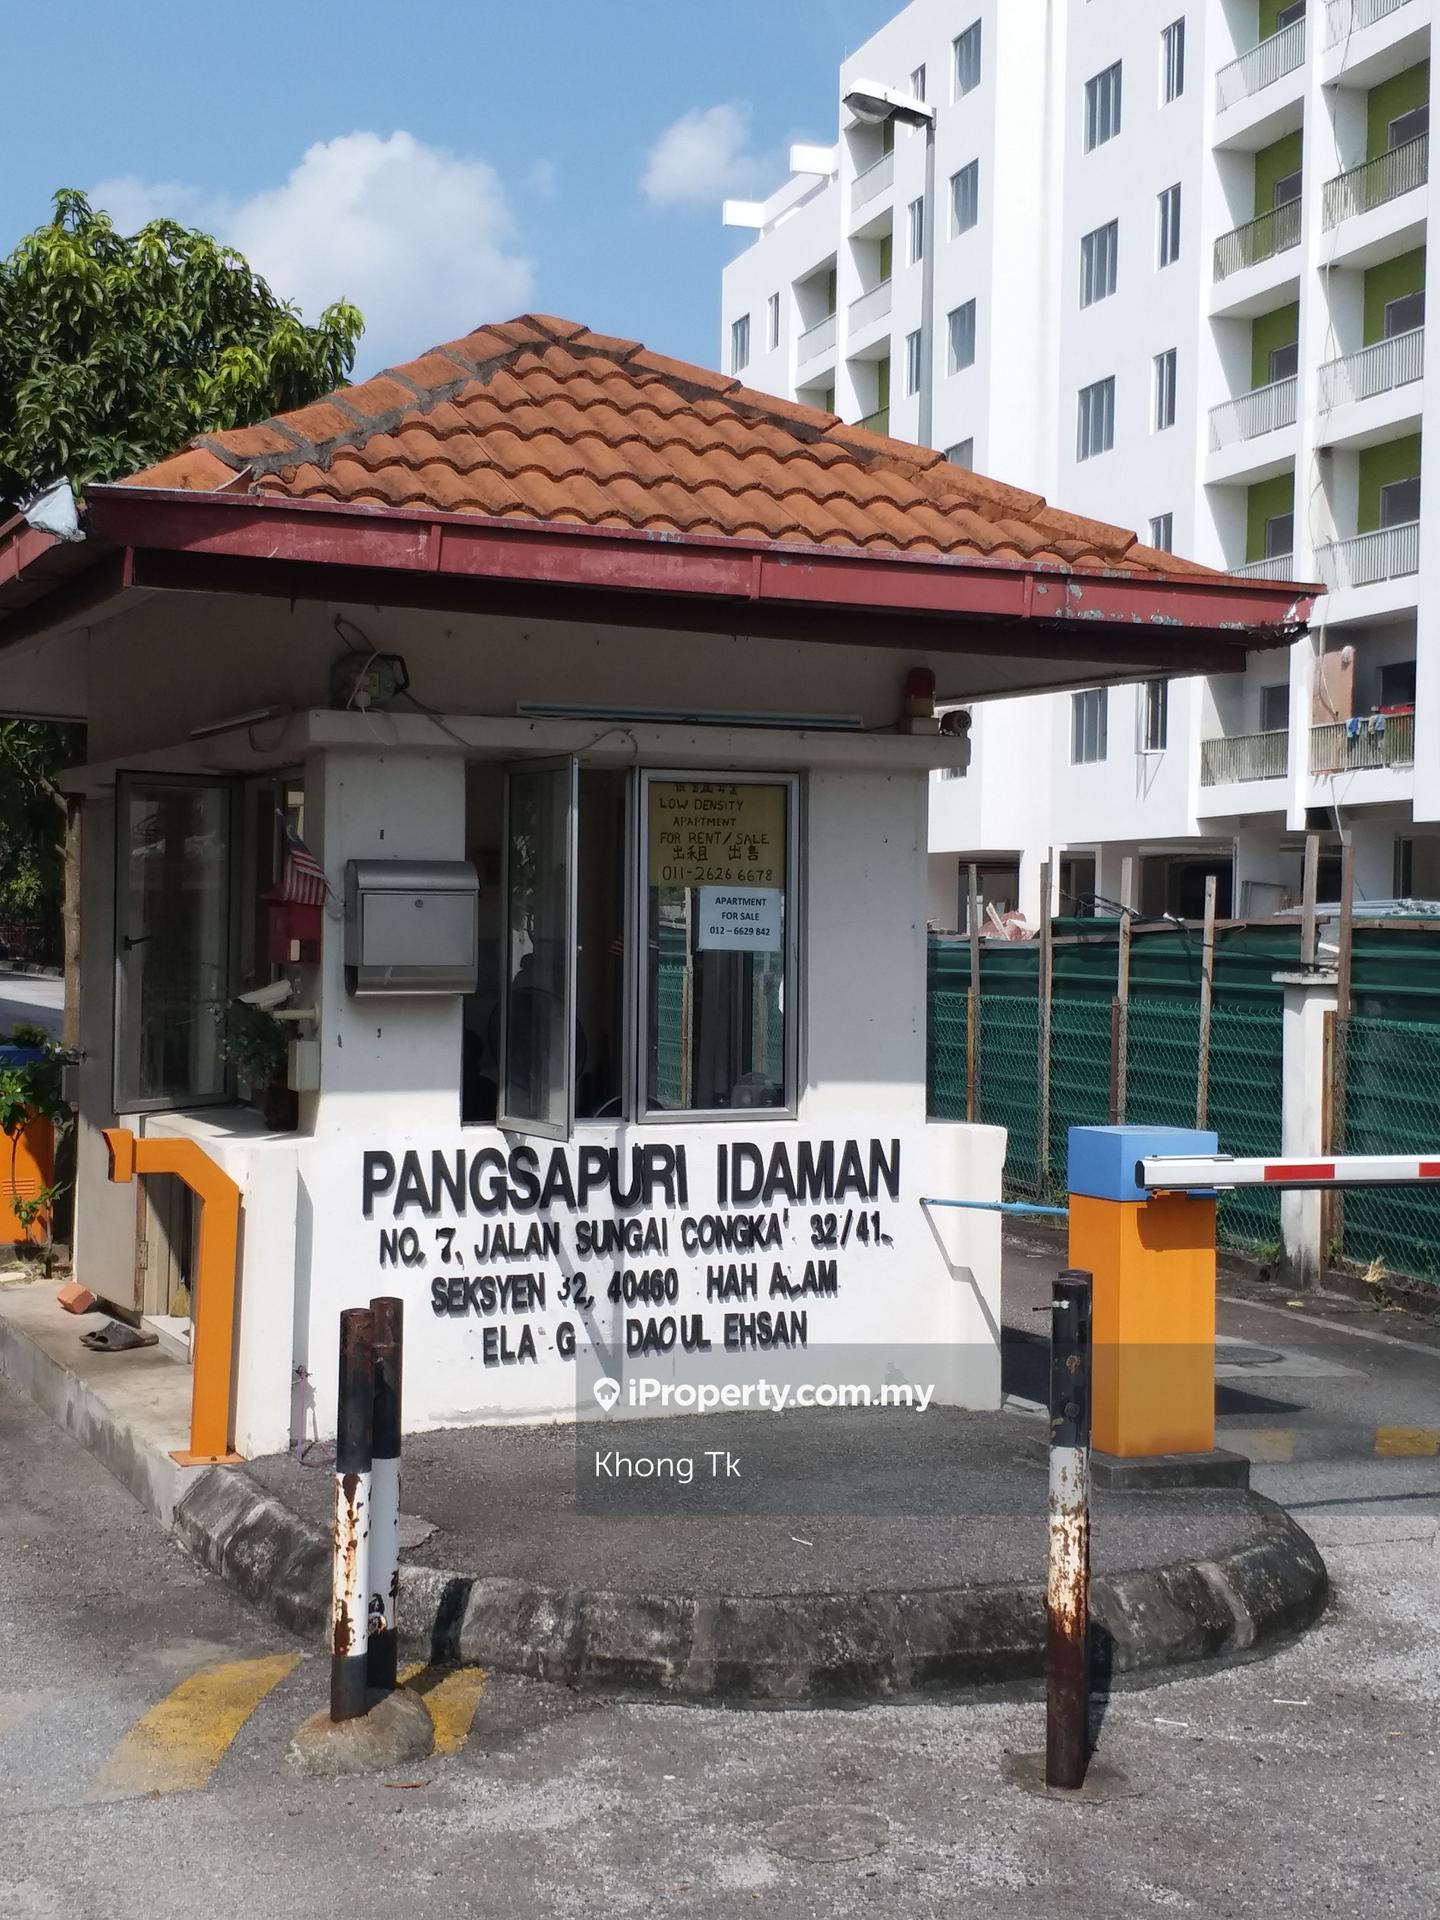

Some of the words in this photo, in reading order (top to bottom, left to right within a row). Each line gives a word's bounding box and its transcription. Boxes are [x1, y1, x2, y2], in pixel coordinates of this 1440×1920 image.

[659, 798, 688, 810] LOW
[694, 799, 744, 811] DENSITY
[660, 832, 681, 844] FOR
[662, 865, 732, 881] 011-2626
[737, 869, 773, 881] 6678
[715, 897, 767, 906] APARTMENT
[721, 912, 738, 920] FOR
[740, 912, 759, 921] SALE
[709, 926, 724, 935] 012
[733, 927, 753, 935] 6629
[755, 928, 770, 936] 842
[362, 1143, 689, 1217] PANGSAPURI
[717, 1138, 900, 1208] IDAMAN
[474, 1221, 560, 1263] JALAN
[575, 1216, 667, 1261] SUNGAI
[431, 1271, 546, 1316] SEKSYEN
[607, 1267, 679, 1309] 40460
[723, 1310, 808, 1352] EHSAN
